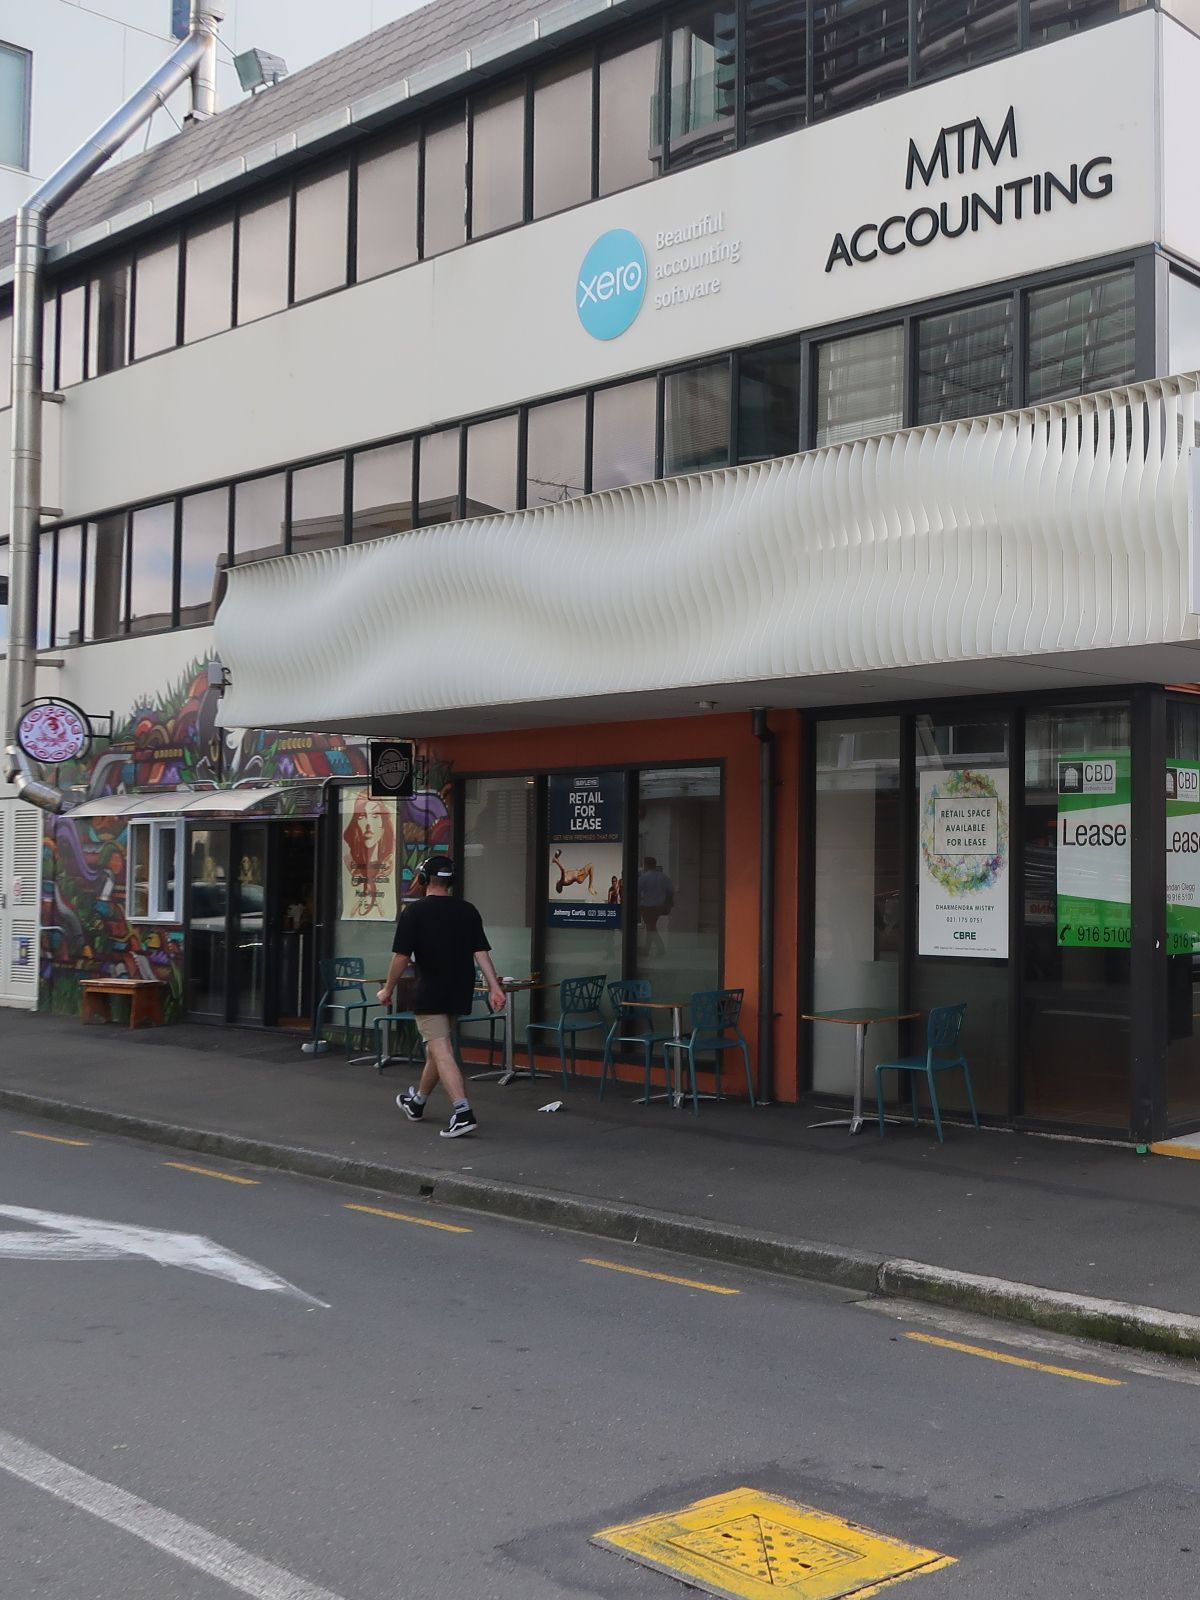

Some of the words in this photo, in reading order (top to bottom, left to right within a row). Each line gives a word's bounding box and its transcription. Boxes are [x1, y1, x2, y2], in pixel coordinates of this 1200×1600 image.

[905, 105, 1018, 190] MTM
[825, 156, 1113, 272] ACCOUNTING
[656, 210, 724, 250] Beautiful
[655, 240, 741, 280] accounting
[579, 261, 642, 308] xero
[655, 277, 721, 310] software
[1085, 764, 1113, 782] CBD
[1178, 771, 1198, 790] CBD
[569, 792, 604, 804] RETAIL
[575, 805, 595, 817] FOR
[941, 810, 965, 818] RETAIL
[967, 809, 991, 818] SPACE
[570, 818, 602, 830] LEASE
[945, 824, 985, 832] AVAILABLE
[1063, 819, 1127, 846] Lease
[964, 838, 987, 846] LEASE
[953, 931, 977, 940] CBRE
[1077, 927, 1100, 942] 916
[1103, 927, 1131, 943] 5100
